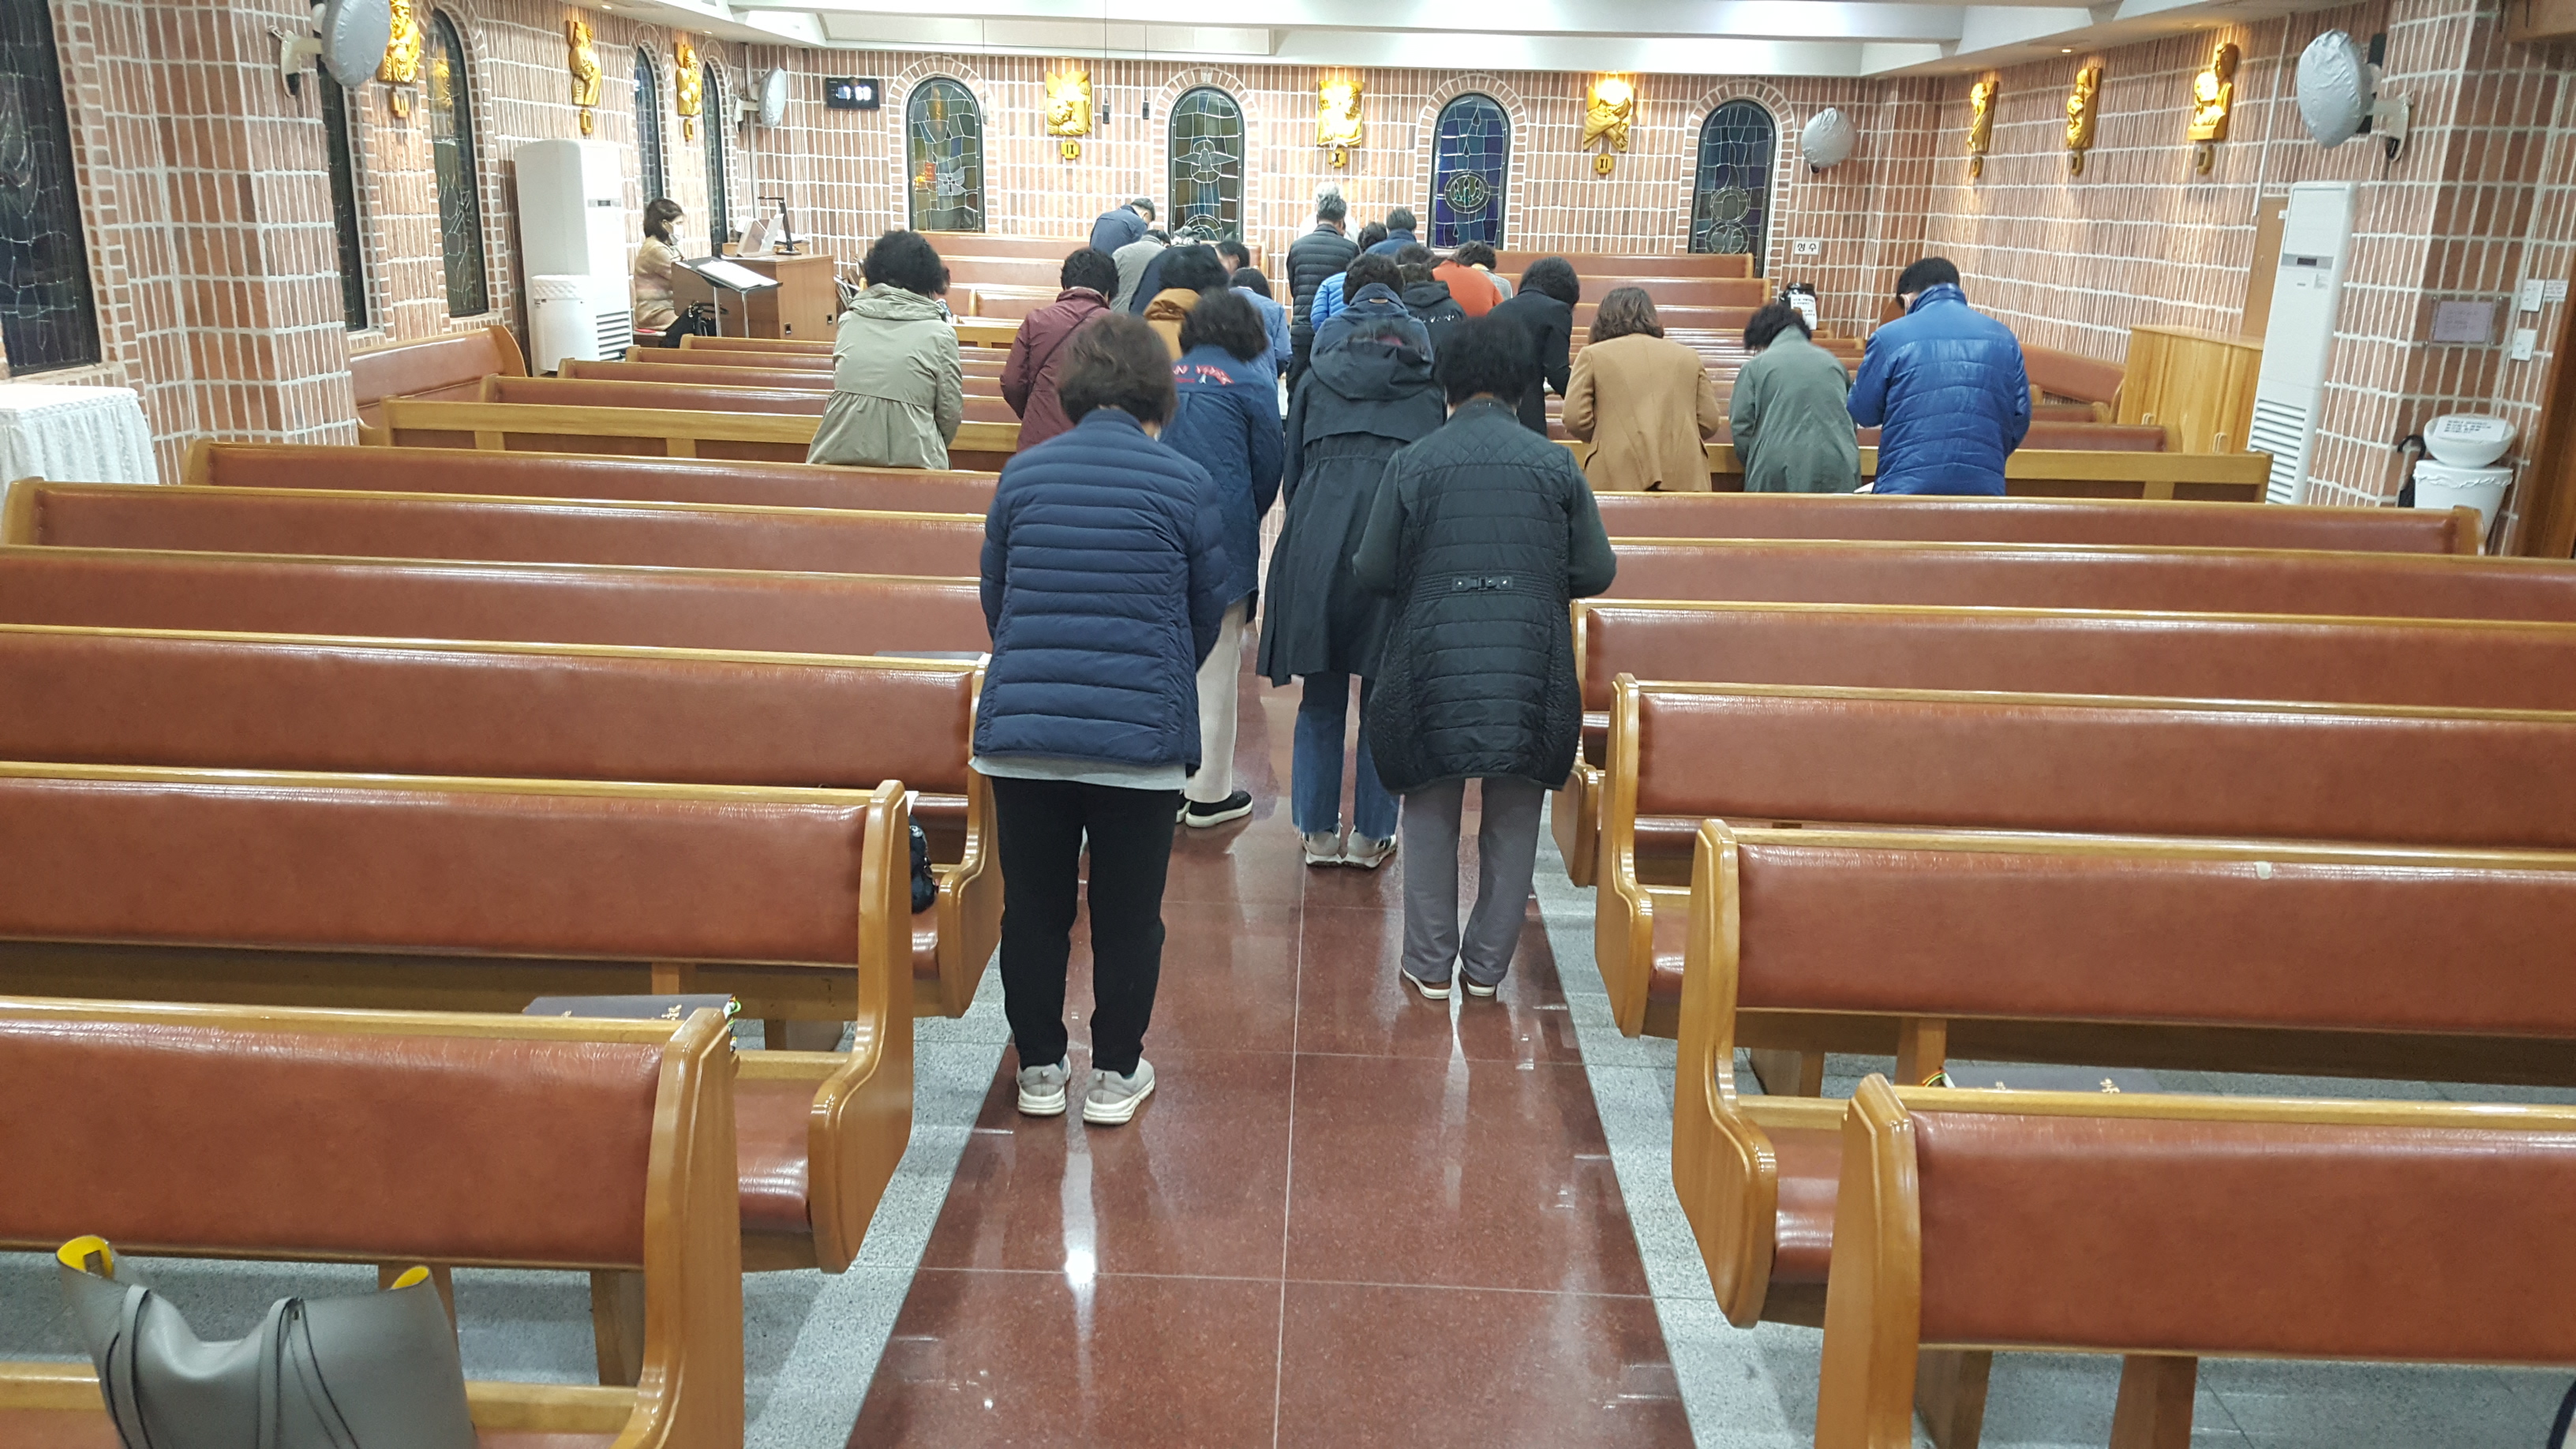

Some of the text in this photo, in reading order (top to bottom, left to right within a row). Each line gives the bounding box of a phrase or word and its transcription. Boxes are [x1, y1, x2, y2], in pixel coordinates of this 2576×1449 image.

[1066, 144, 1074, 155] IX
[1335, 152, 1340, 163] X
[1600, 158, 1608, 169] XI
